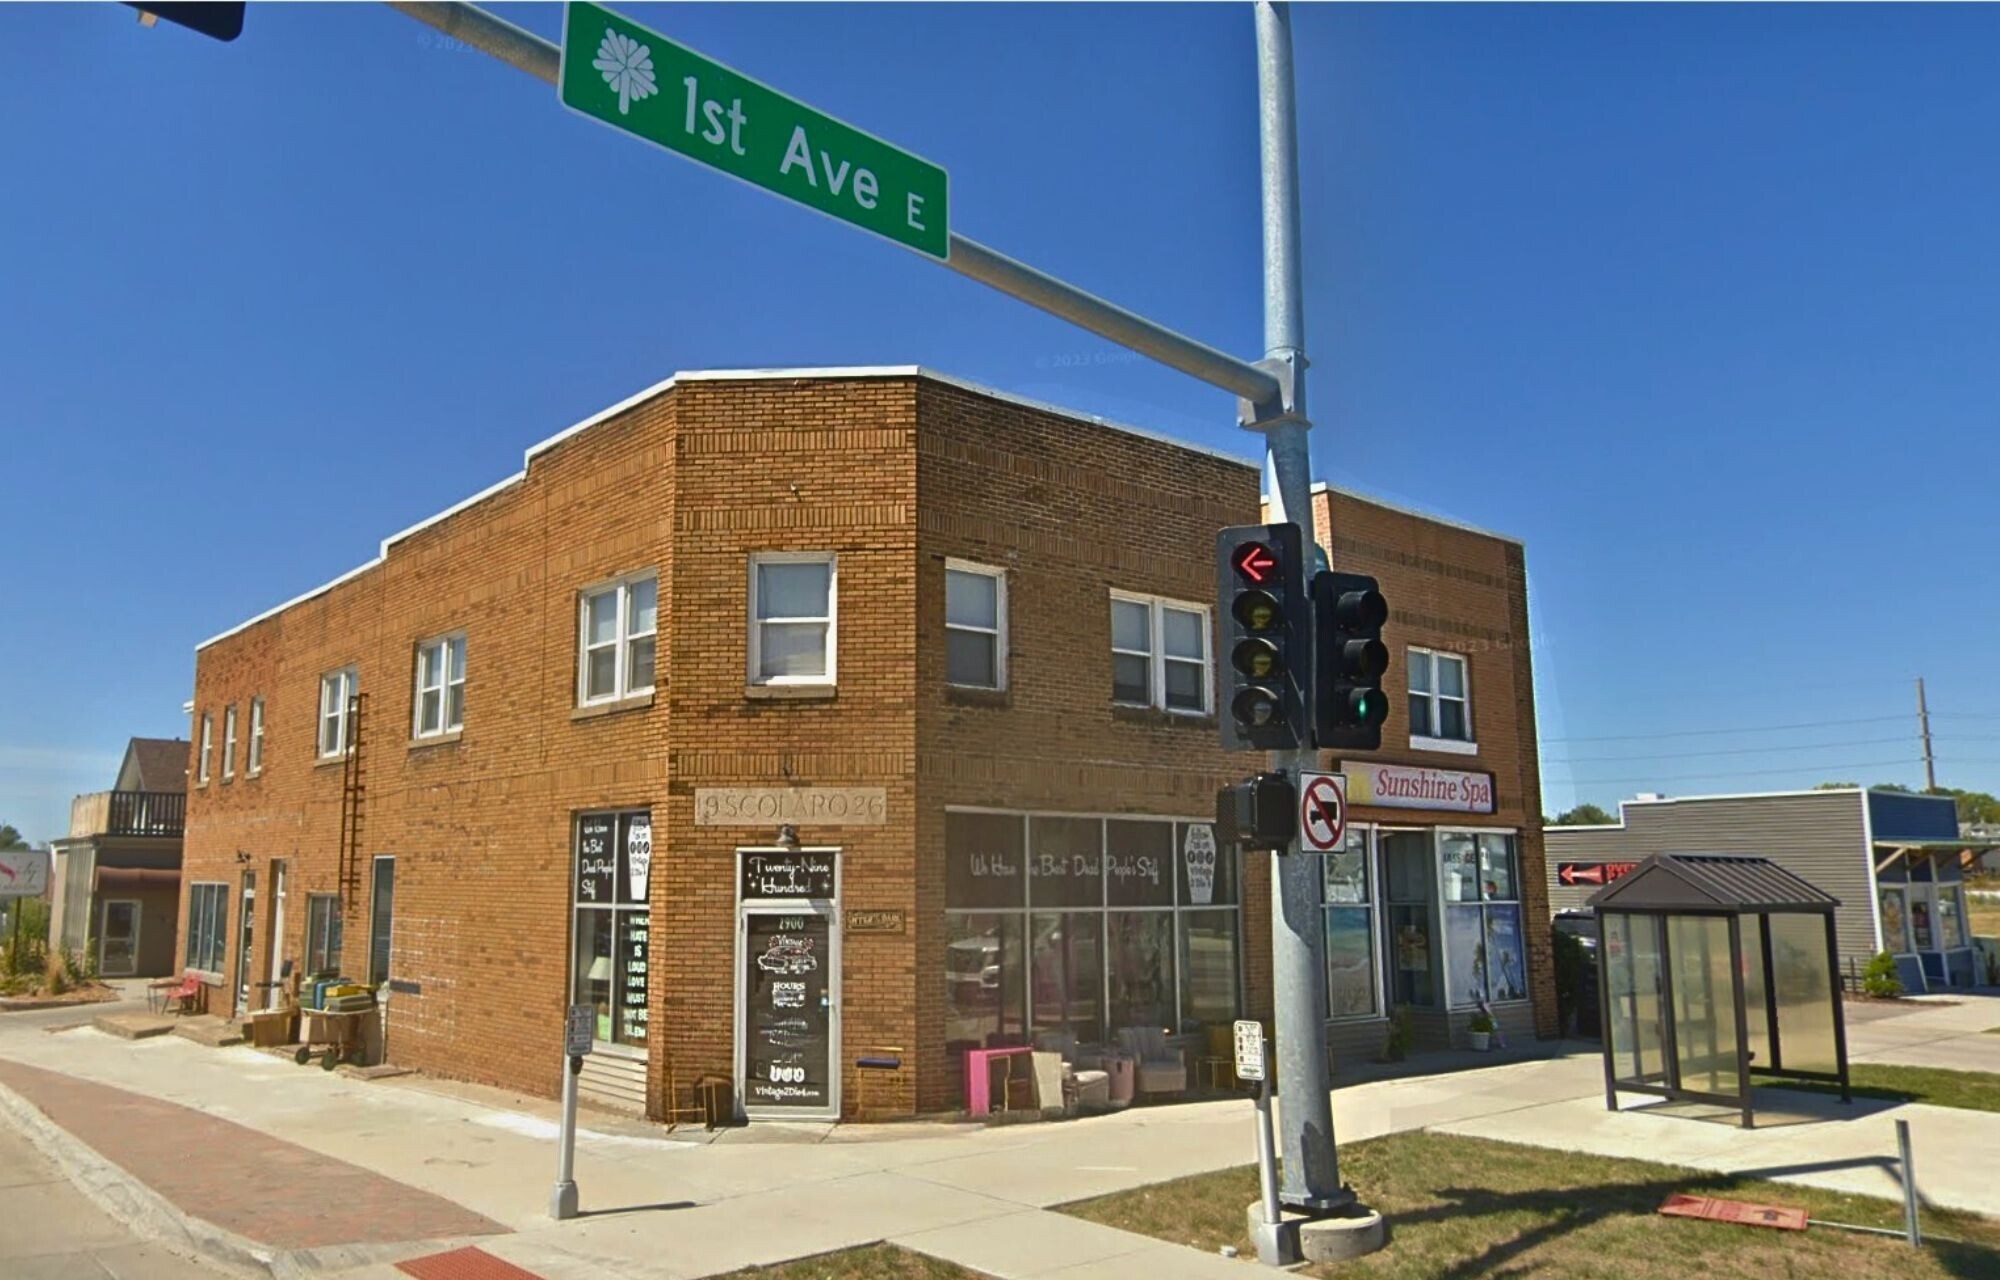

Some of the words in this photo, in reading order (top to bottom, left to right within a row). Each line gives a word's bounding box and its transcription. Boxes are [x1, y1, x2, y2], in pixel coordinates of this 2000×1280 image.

[683, 76, 747, 156] 1st
[779, 125, 880, 210] Ave
[907, 192, 925, 231] E
[1375, 768, 1457, 801] Sunshine
[1461, 775, 1490, 810] Spa
[970, 853, 987, 876] We
[991, 853, 1017, 876] Have
[1039, 854, 1069, 876] Best
[1073, 854, 1100, 876] Dead
[778, 917, 804, 930] 2900
[627, 976, 645, 988] LOVE
